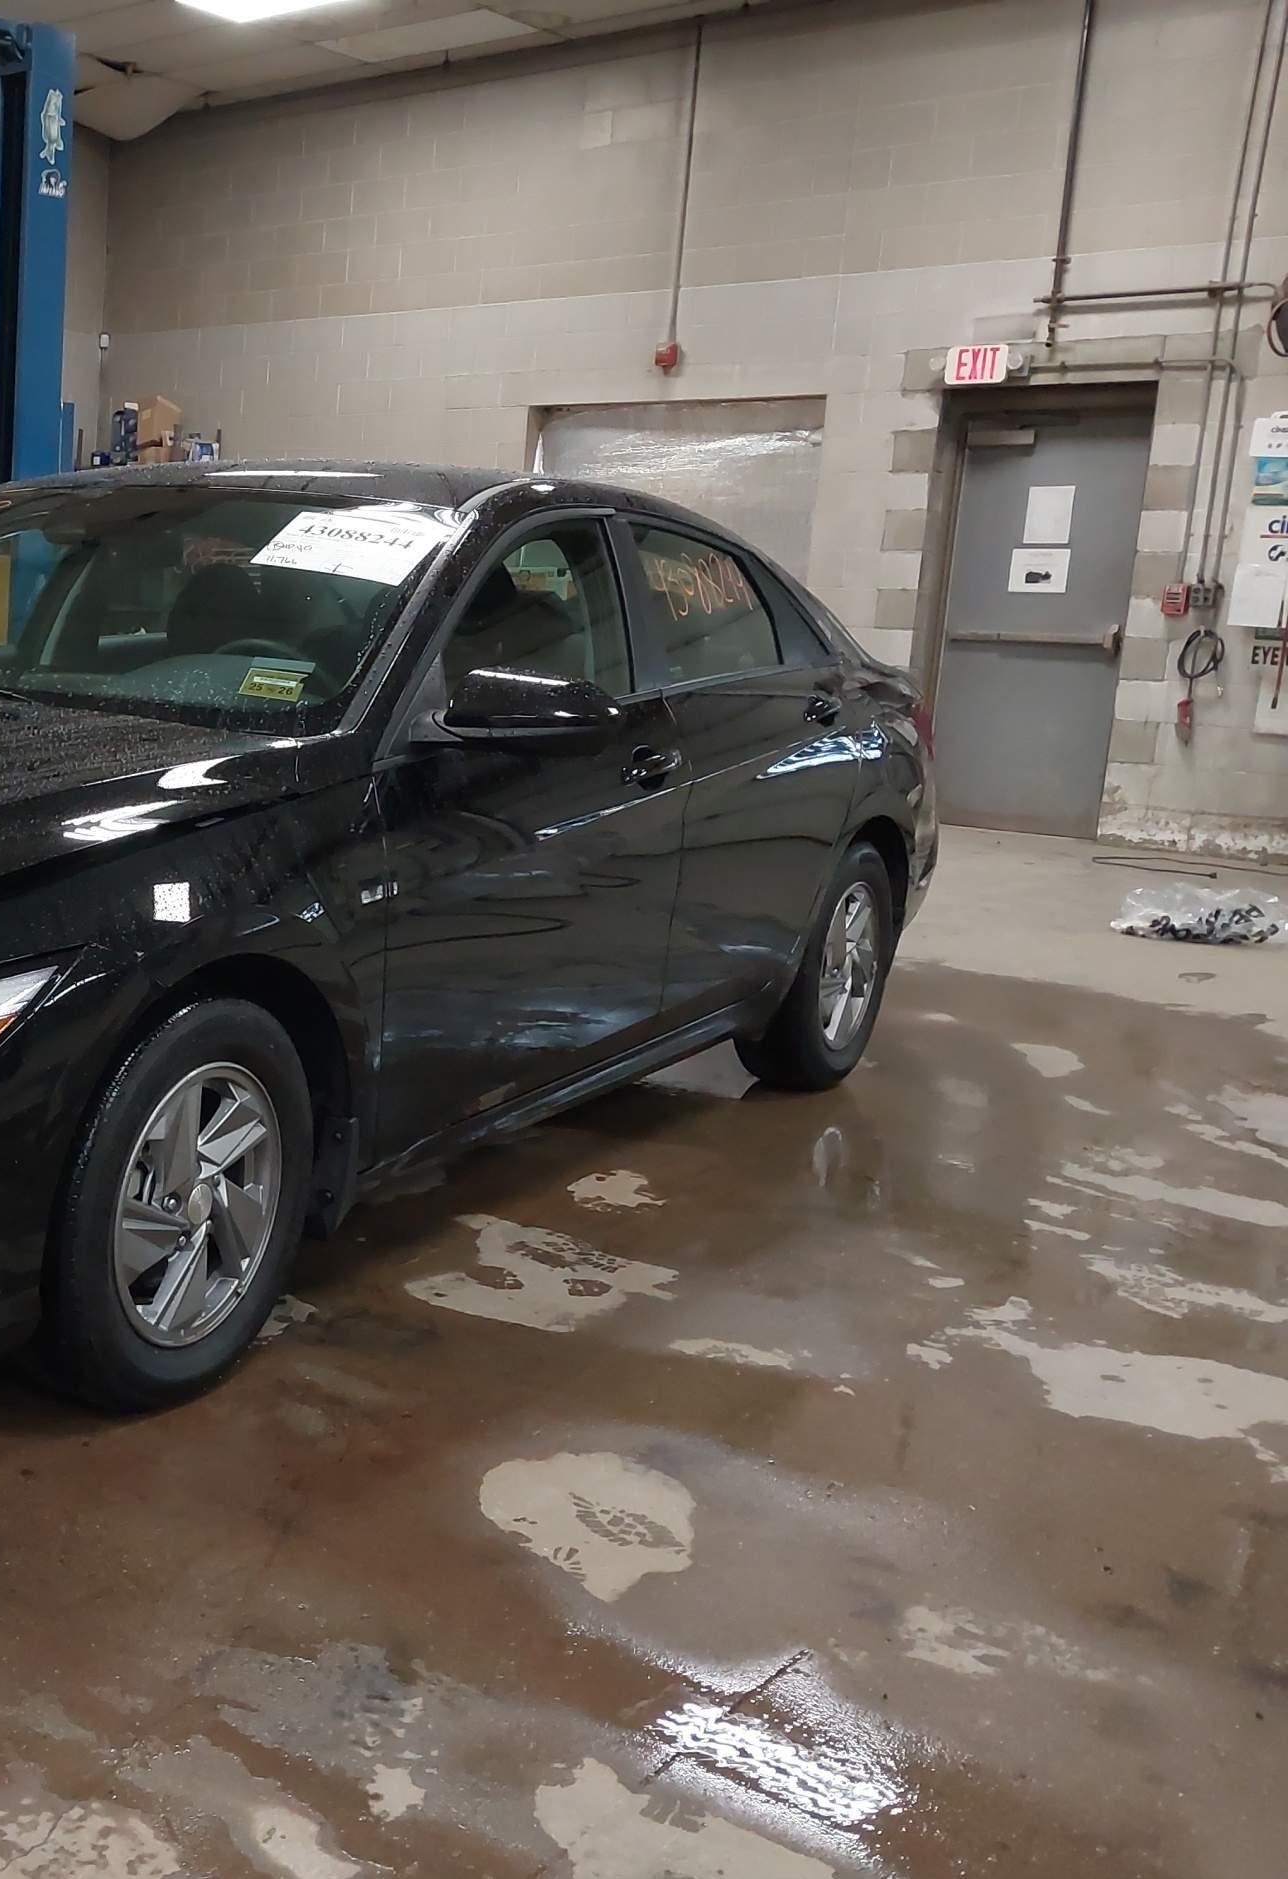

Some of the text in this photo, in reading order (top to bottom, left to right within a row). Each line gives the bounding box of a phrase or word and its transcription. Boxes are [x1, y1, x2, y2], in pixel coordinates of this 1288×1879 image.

[955, 347, 1001, 381] EXIT
[1268, 515, 1288, 534] ci
[299, 524, 414, 549] 43088244
[249, 683, 294, 696] 25 26
